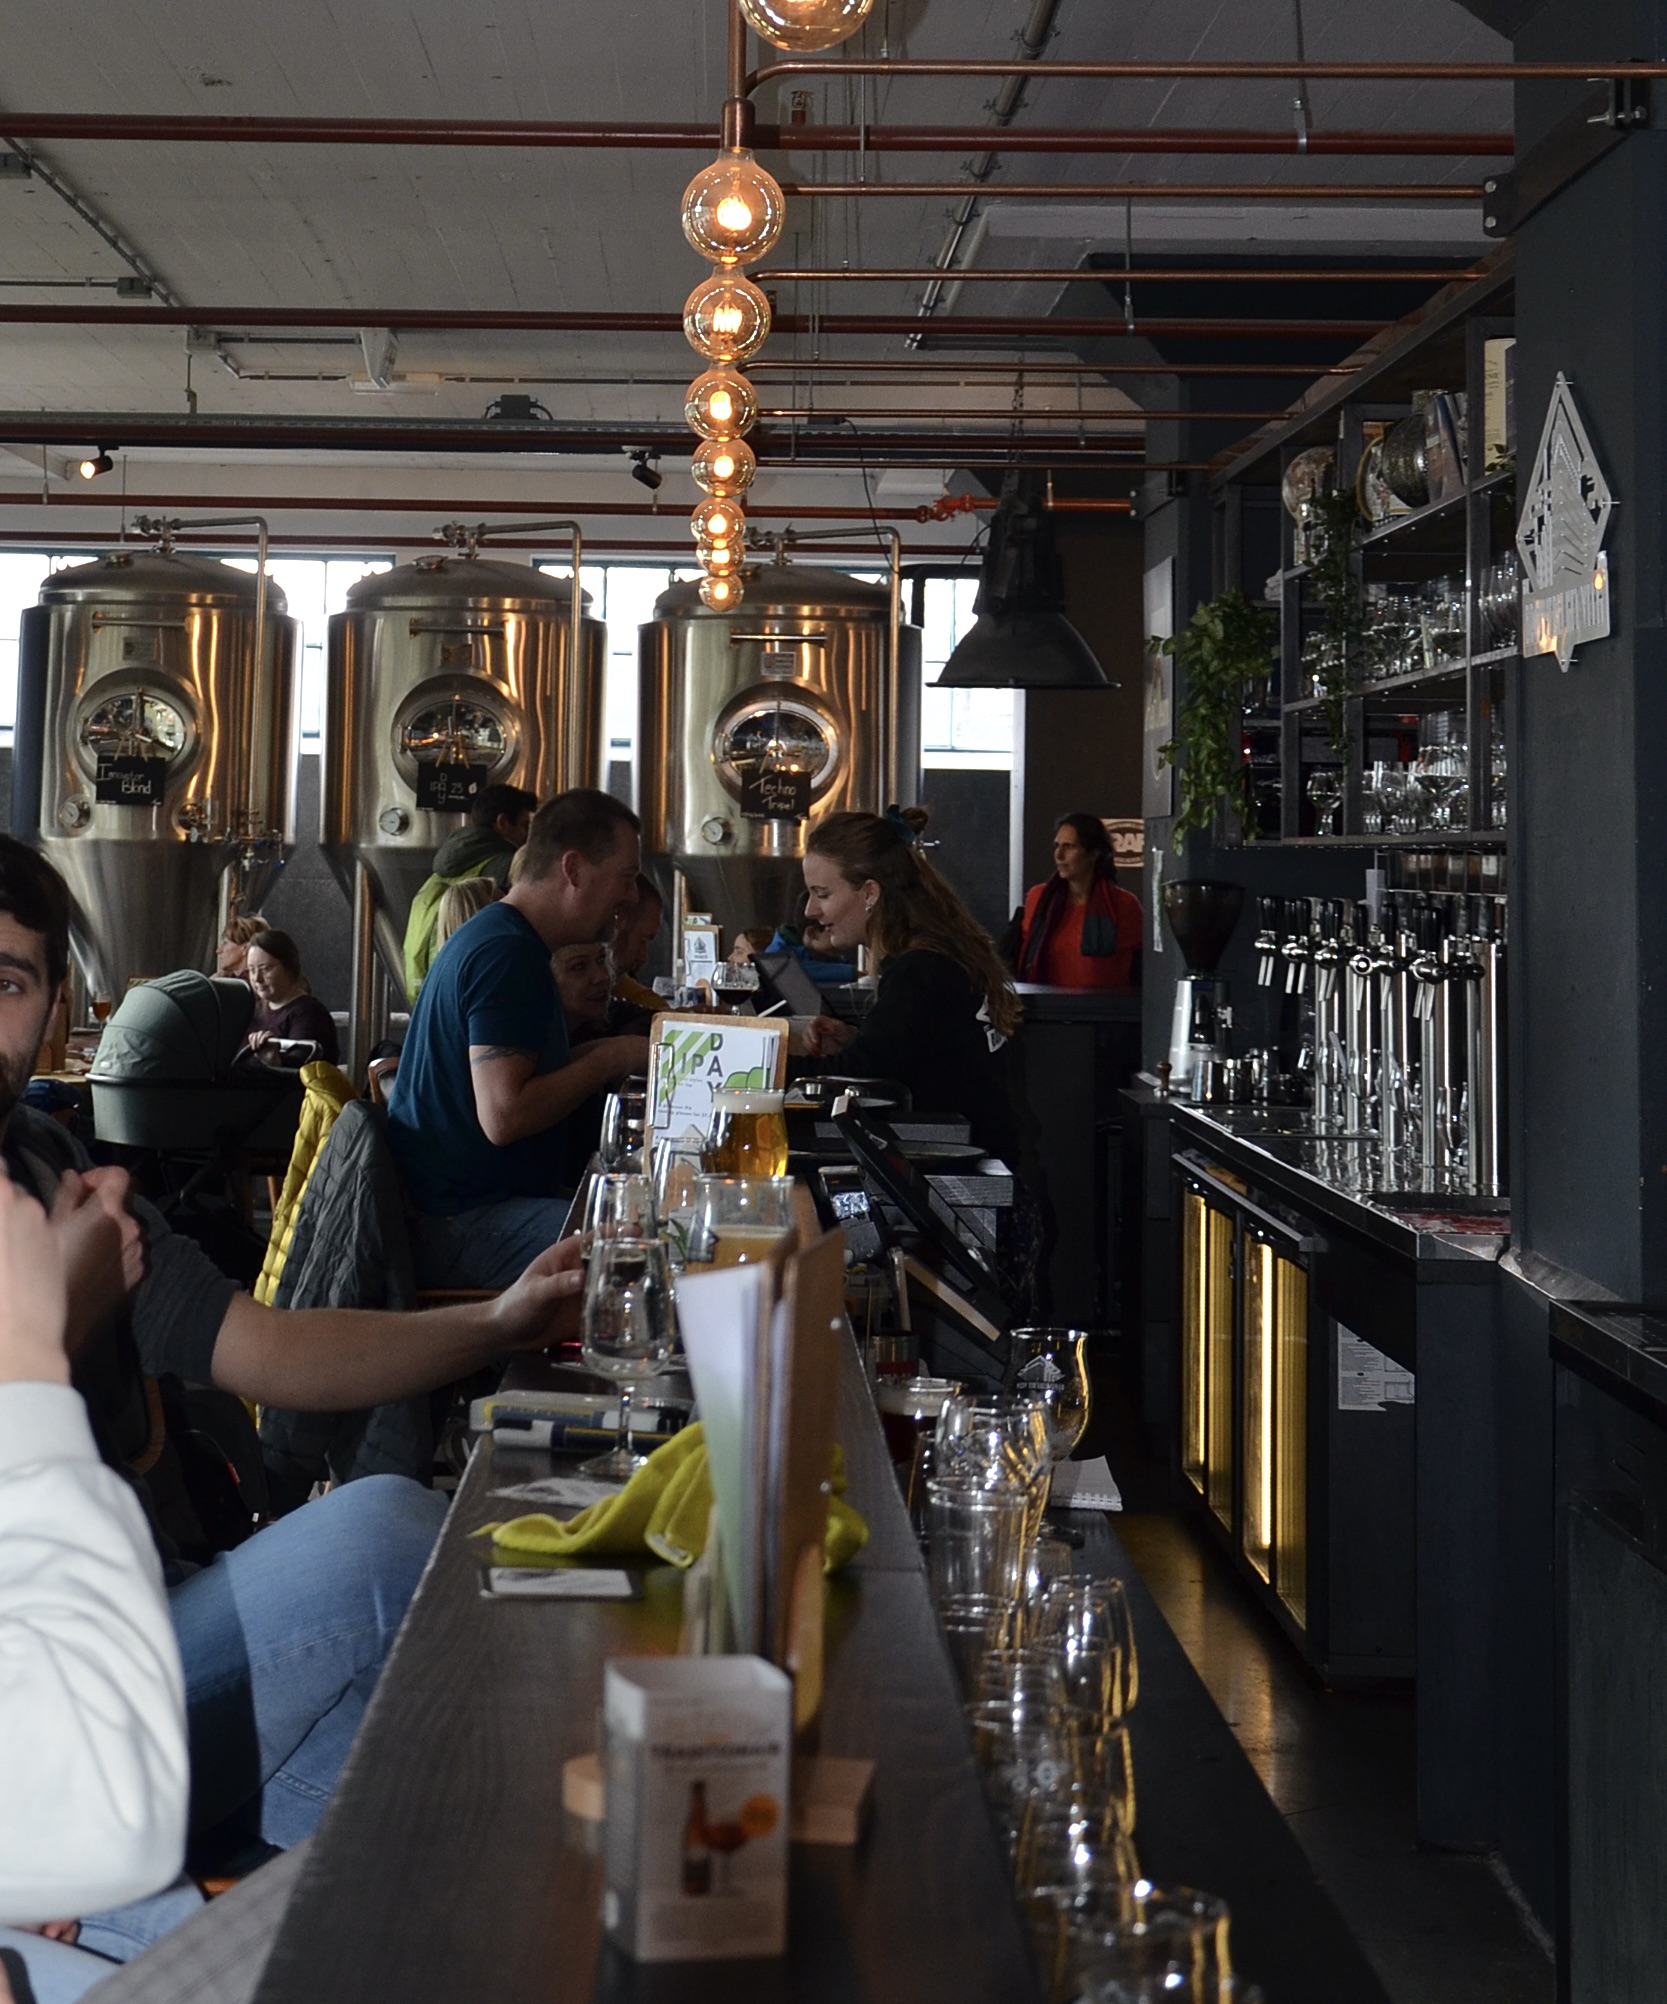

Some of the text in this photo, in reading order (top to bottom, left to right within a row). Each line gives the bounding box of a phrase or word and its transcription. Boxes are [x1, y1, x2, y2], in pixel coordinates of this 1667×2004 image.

[121, 778, 151, 795] Blond
[748, 774, 797, 796] Techno
[761, 794, 795, 811] Tripel
